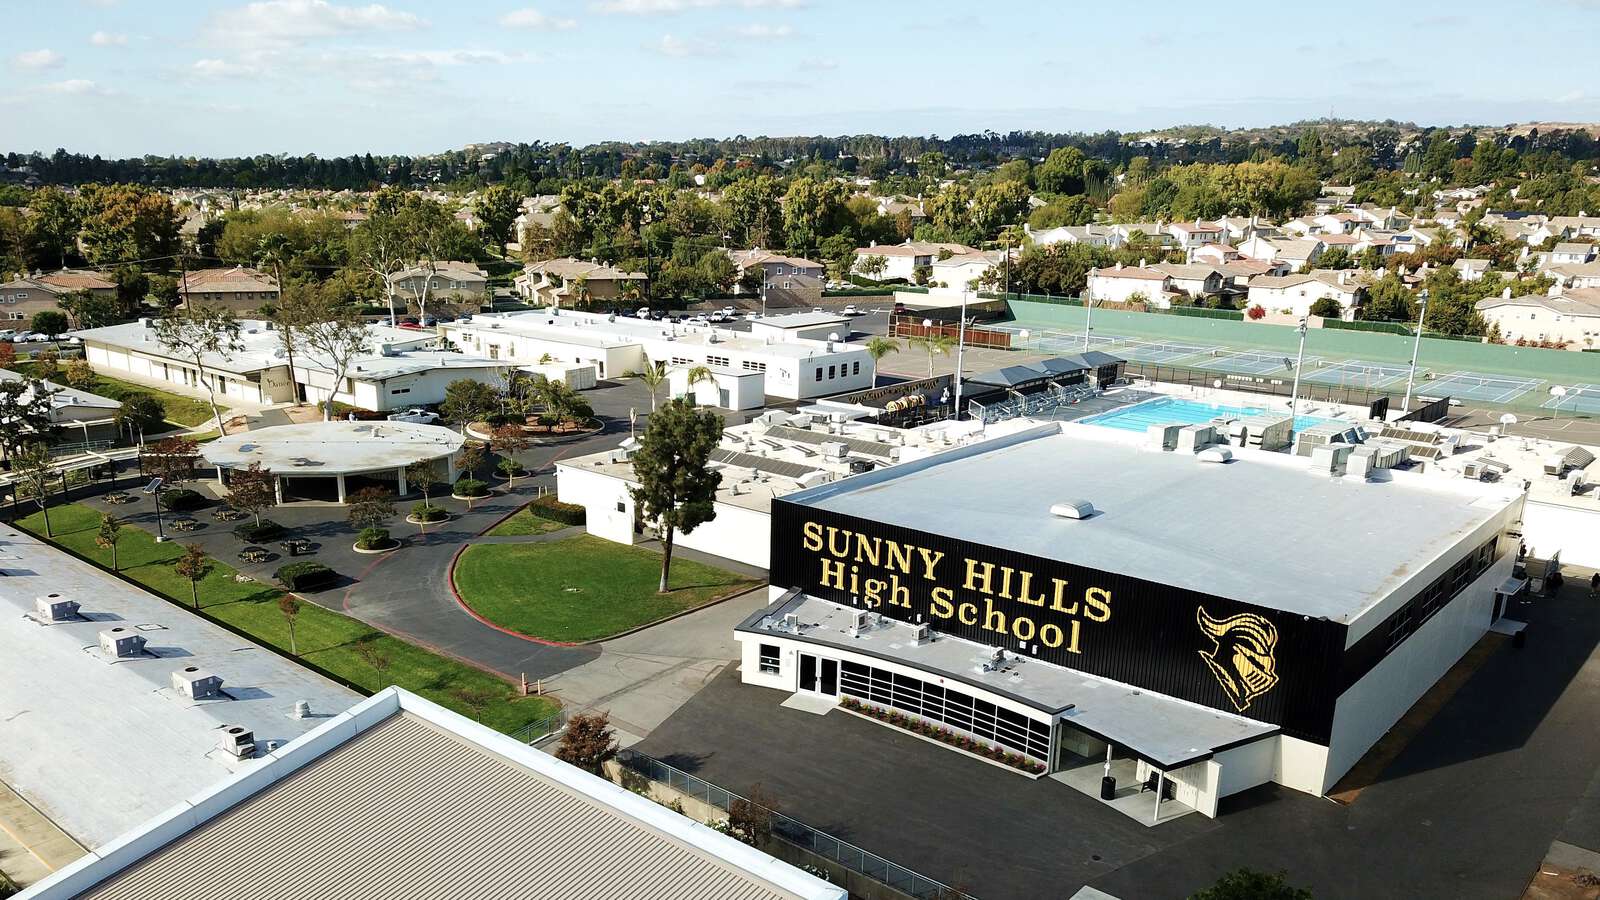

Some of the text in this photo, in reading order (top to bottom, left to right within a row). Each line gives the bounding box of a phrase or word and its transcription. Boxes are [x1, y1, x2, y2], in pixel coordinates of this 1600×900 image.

[803, 521, 1112, 623] SUNNY HILLS
[820, 558, 1081, 653] High School
